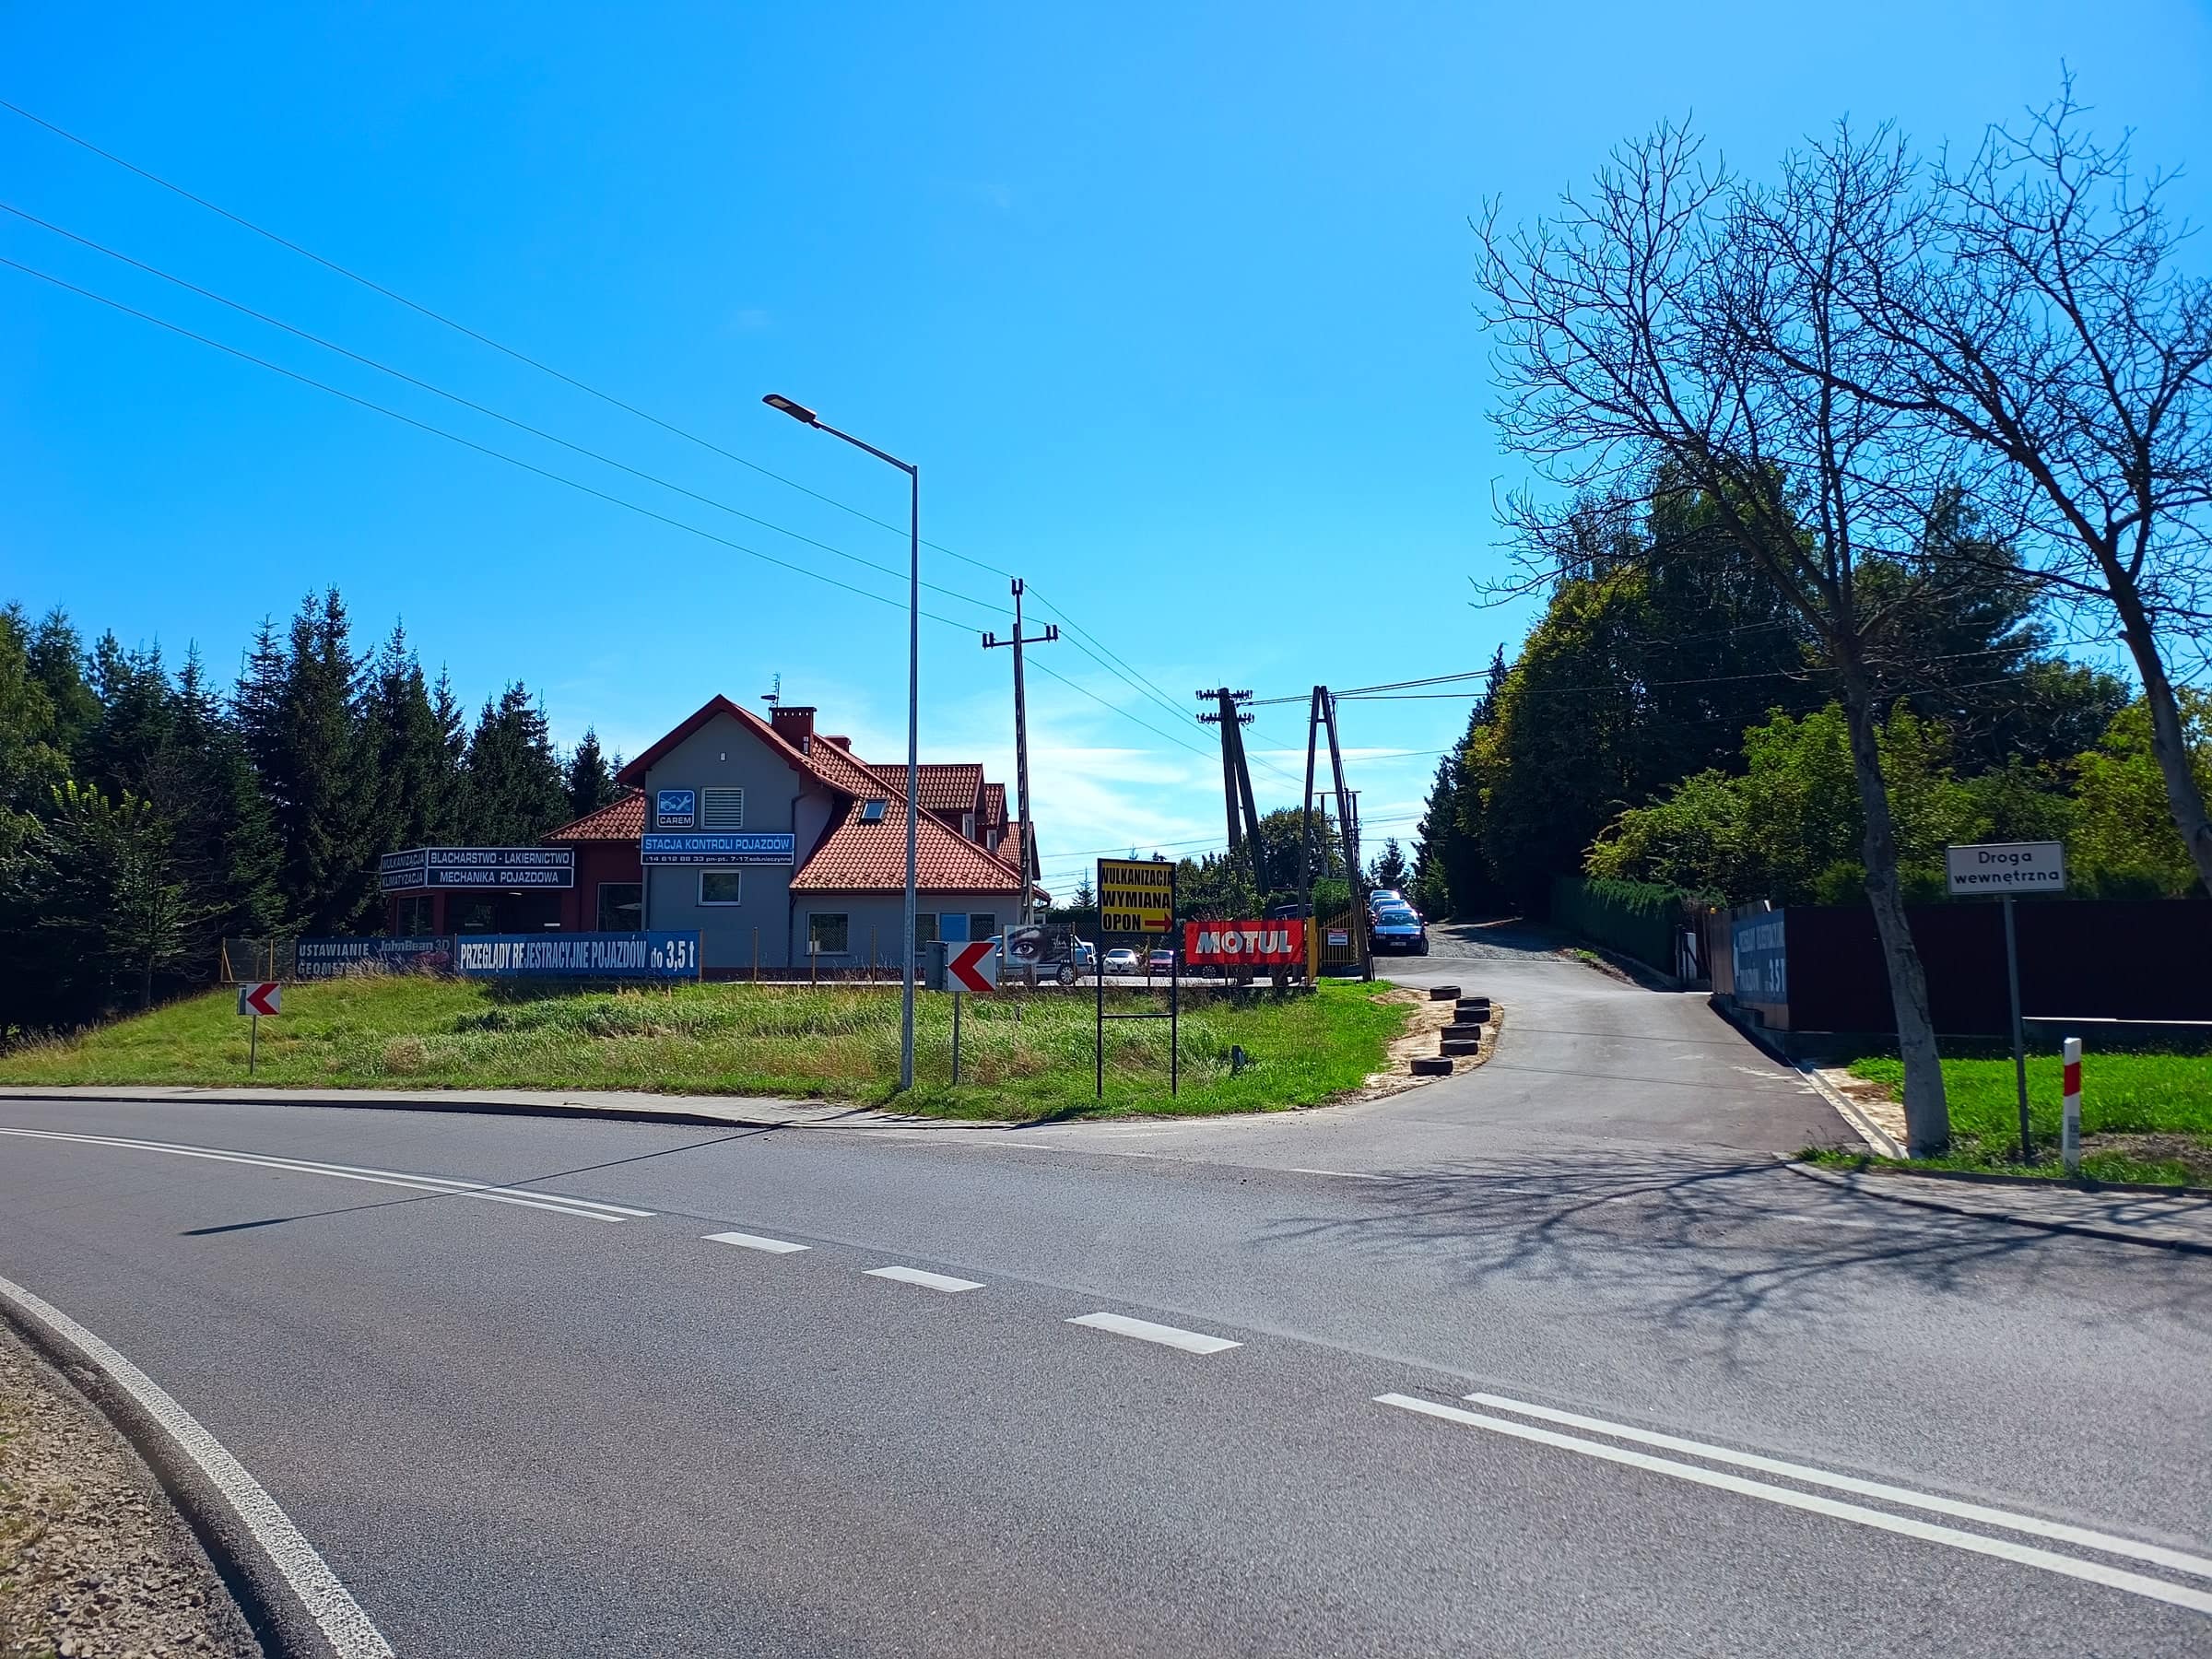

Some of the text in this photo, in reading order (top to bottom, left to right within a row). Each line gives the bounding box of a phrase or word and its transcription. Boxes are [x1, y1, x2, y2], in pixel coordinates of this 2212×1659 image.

[659, 817, 692, 825] CAREM
[645, 836, 790, 850] STACJA KONTROLI POJAZDÓW
[430, 853, 497, 864] BLACHARSTWO
[504, 853, 570, 864] LAKIERNICTWO
[1954, 851, 2059, 885] Droga wewnętrzna
[382, 872, 423, 887] KLIMATYZACJA
[440, 871, 559, 883] MECHANIKA POJAZDOWA
[1101, 890, 1171, 909] WYMIANA
[1102, 912, 1141, 931] OPON
[435, 938, 450, 951] 3D
[1195, 930, 1293, 954] MOTUL
[299, 943, 369, 958] USTAWIANIE
[460, 935, 695, 971] PRZEGLĄDY REJESTRACYJNE POJAZDÓW do 3,5 t
